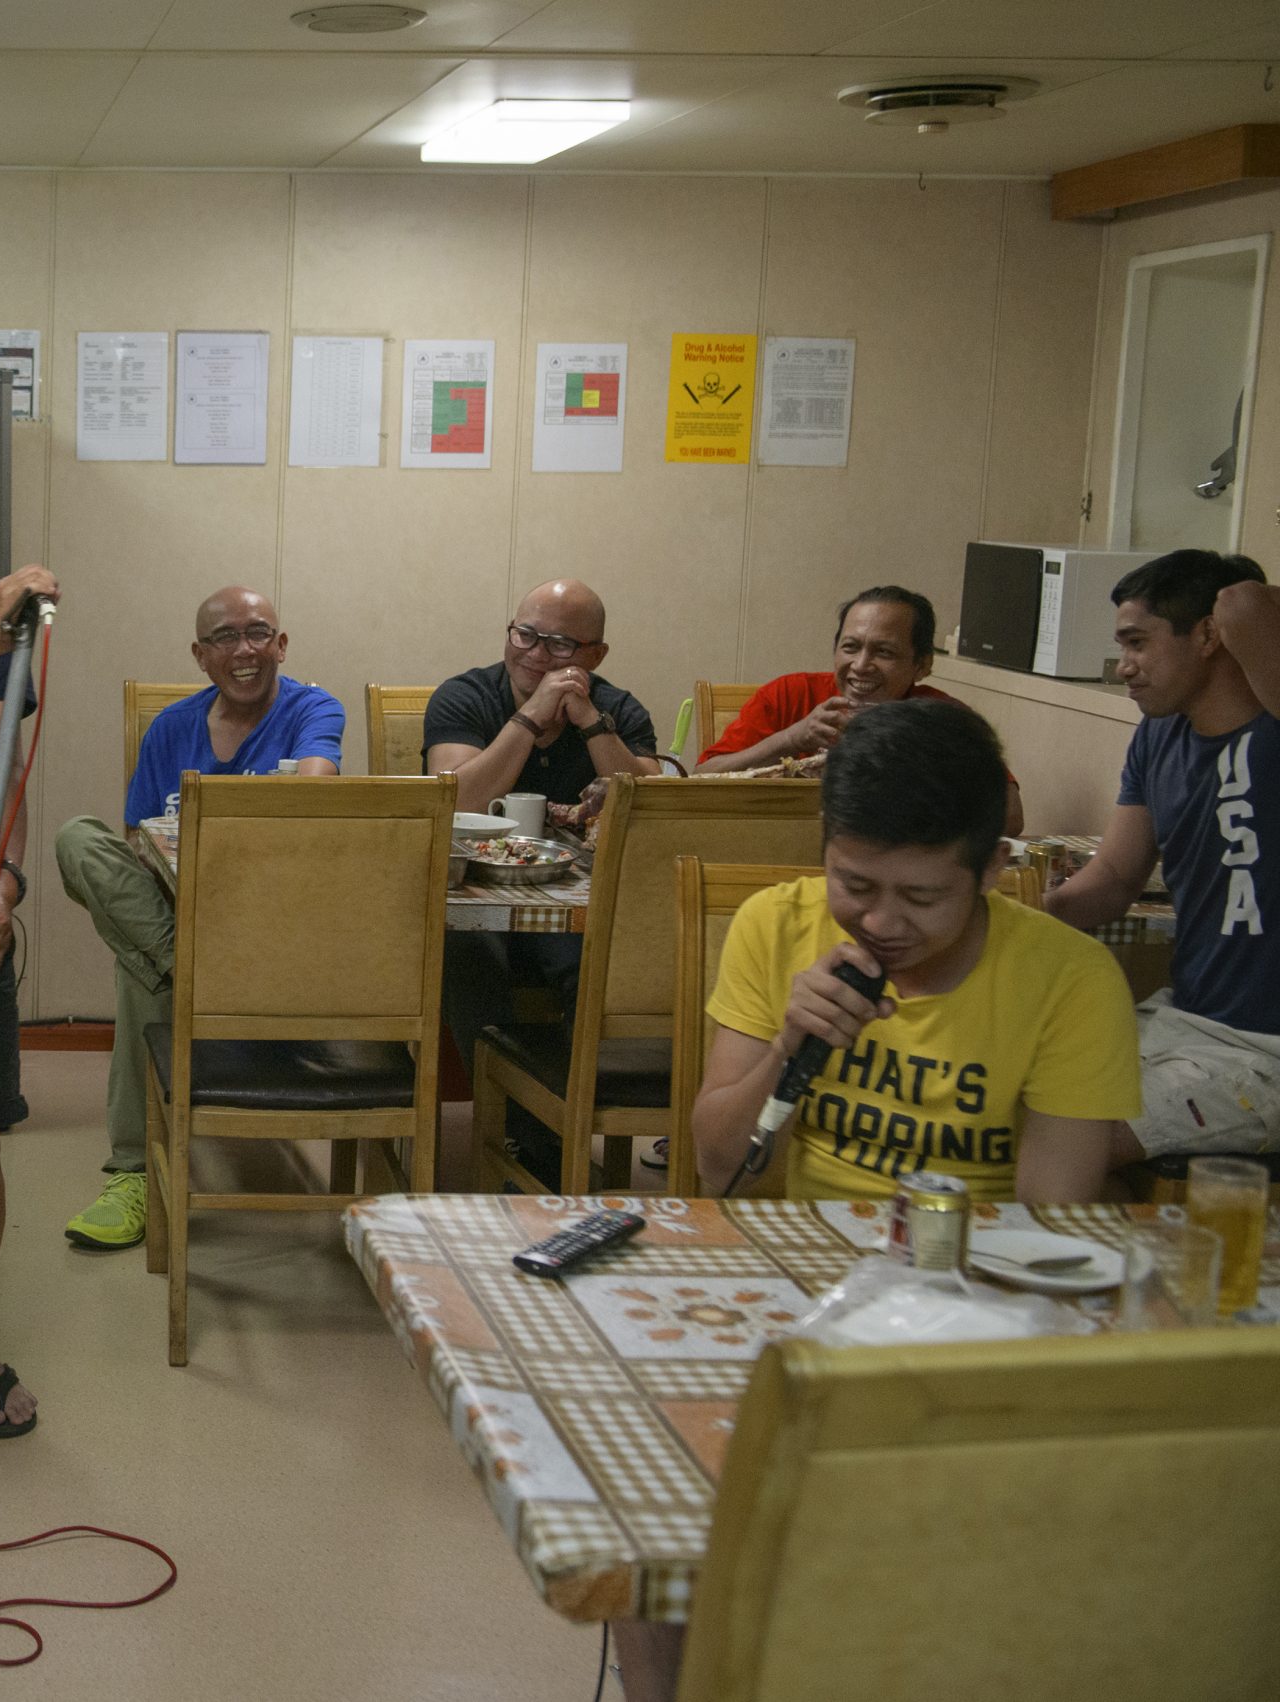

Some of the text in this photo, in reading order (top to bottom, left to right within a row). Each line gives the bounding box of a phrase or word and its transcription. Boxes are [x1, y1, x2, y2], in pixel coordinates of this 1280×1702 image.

[684, 343, 745, 353] Drug & Alcohol
[684, 352, 745, 364] Warning Notice
[1216, 731, 1264, 936] USA
[838, 1039, 988, 1115] HAT'S
[800, 1086, 1013, 1164] TOPPING
